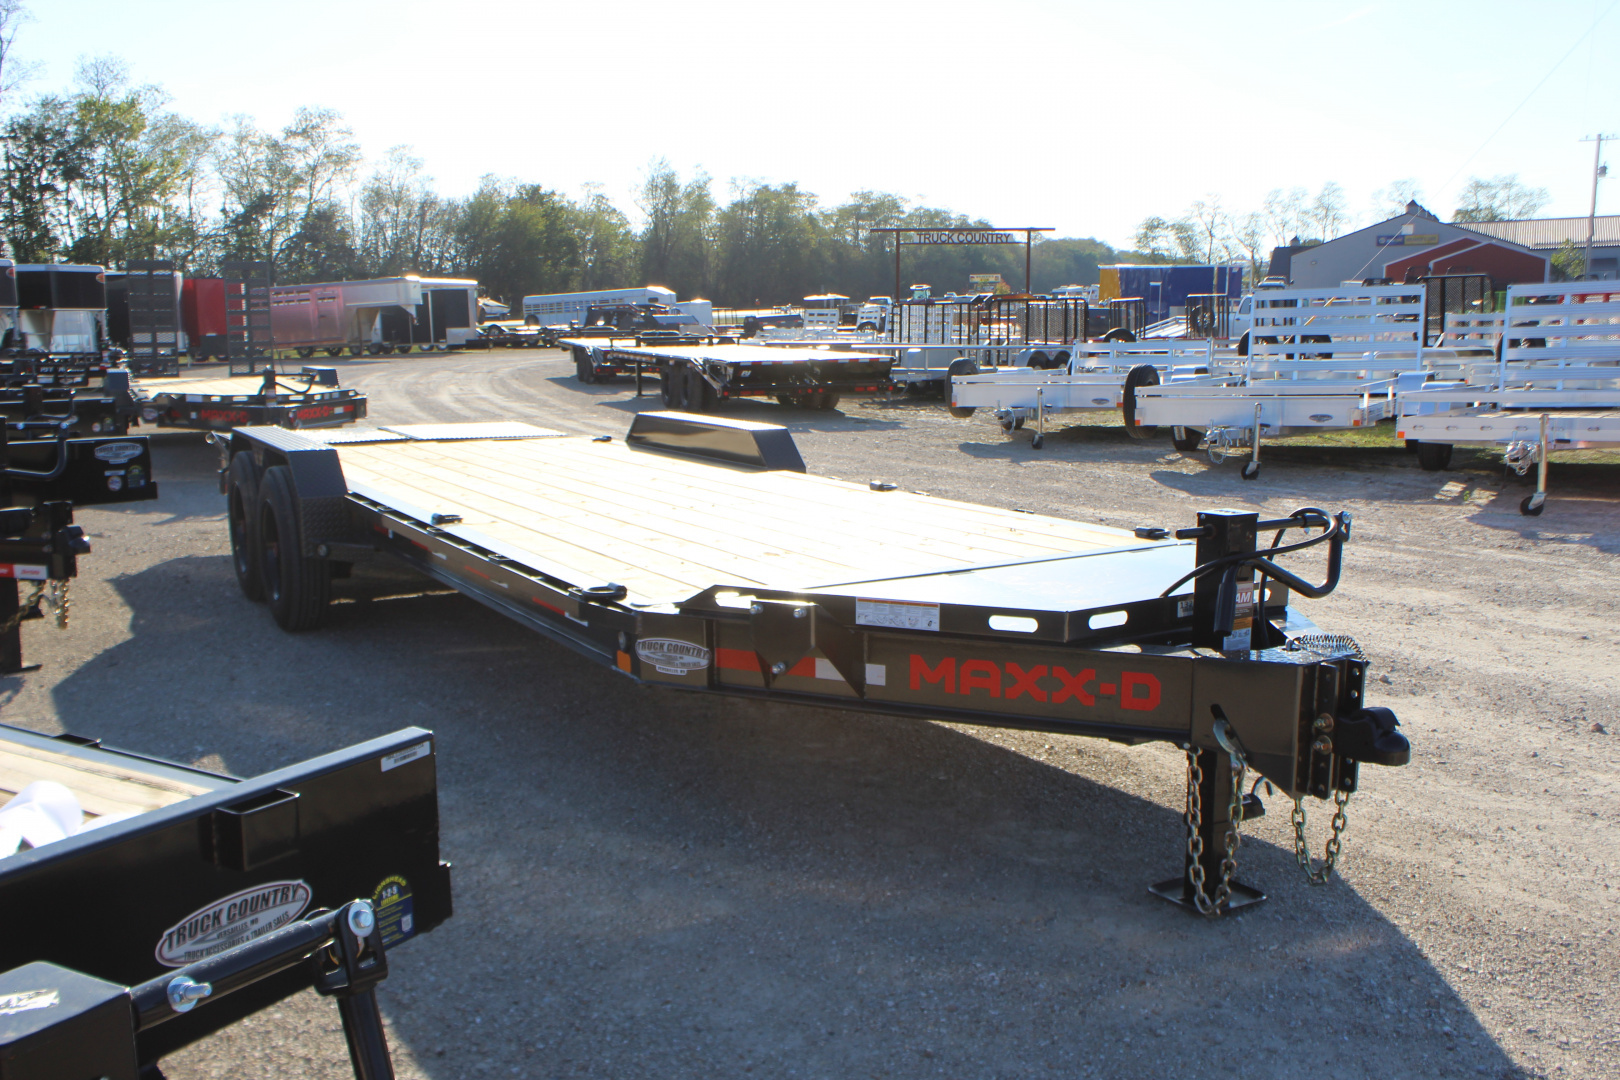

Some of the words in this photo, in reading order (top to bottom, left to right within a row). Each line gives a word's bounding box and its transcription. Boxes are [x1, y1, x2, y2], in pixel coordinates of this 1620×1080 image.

[917, 232, 954, 244] TRUCK
[957, 233, 1011, 244] COUNTRY
[201, 409, 249, 422] MAXX-D
[297, 406, 329, 420] MAXX-D
[1235, 591, 1251, 604] AM
[638, 642, 665, 651] TRUCK
[667, 643, 708, 659] COUNTRY
[909, 653, 1162, 712] MAXX-D
[166, 908, 223, 951] TRUCK
[226, 883, 300, 923] COUNTRY
[250, 922, 272, 939] TRAILER
[273, 911, 289, 928] SALES
